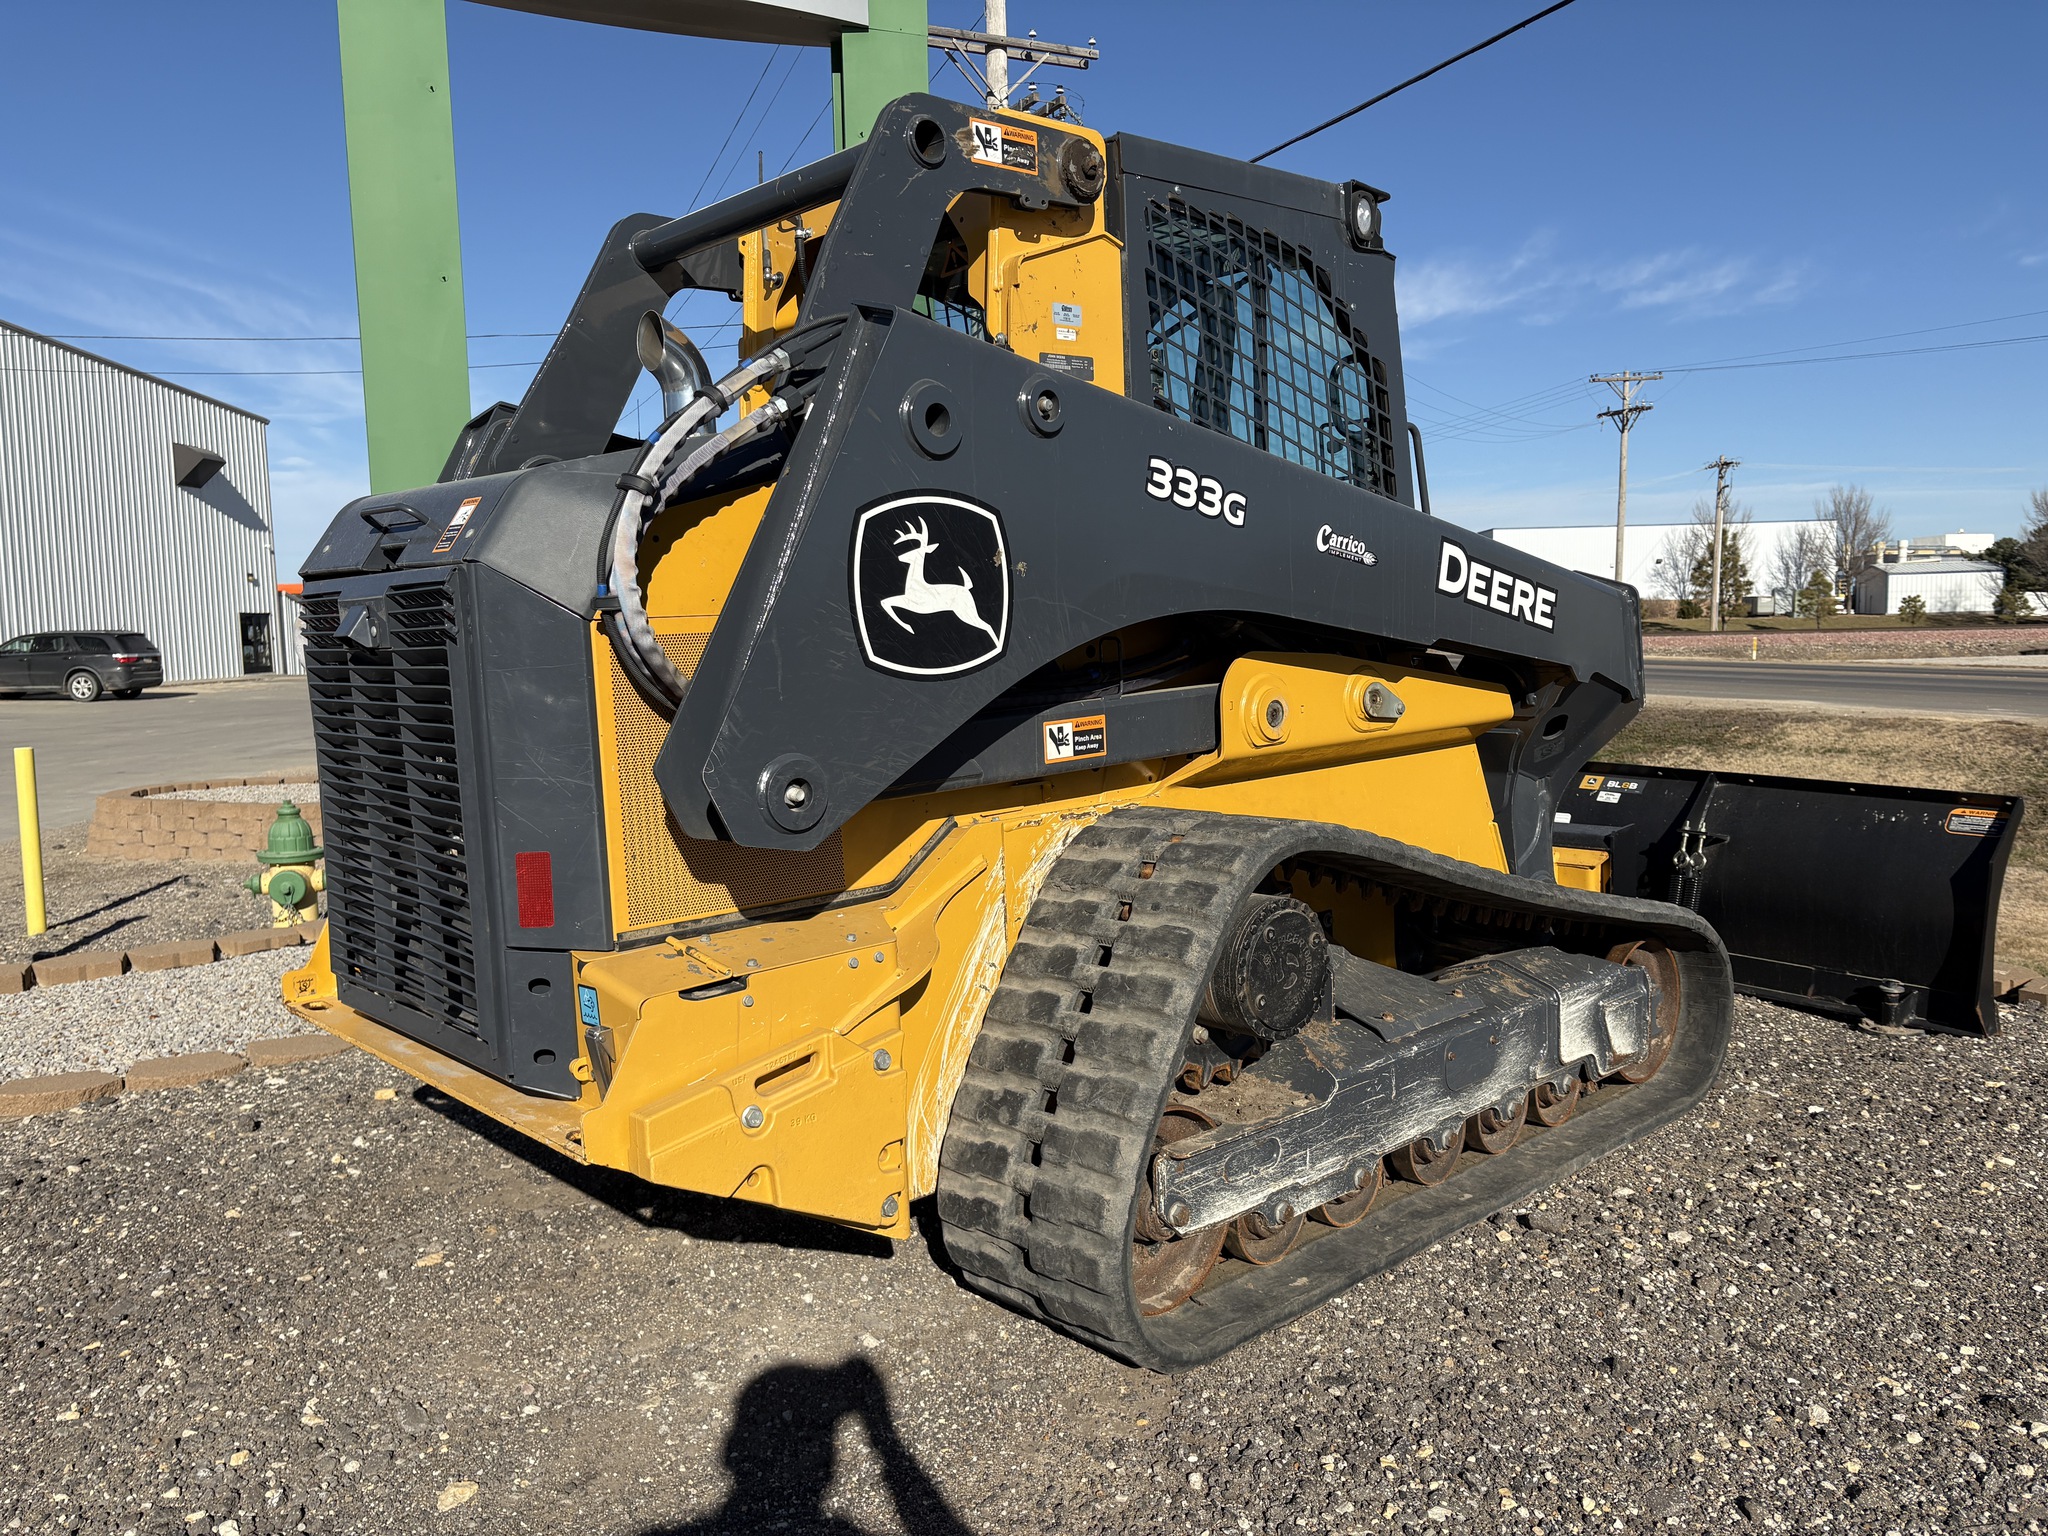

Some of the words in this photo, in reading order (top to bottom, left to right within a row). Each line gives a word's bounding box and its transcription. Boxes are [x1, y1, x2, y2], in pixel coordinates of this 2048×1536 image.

[1008, 130, 1035, 141] WARNING
[1146, 457, 1248, 527] 333G
[1316, 524, 1366, 555] Carrico
[1328, 549, 1362, 563] IMPLEMENT
[1437, 540, 1557, 629] DEERE
[1080, 719, 1103, 727] WARNING
